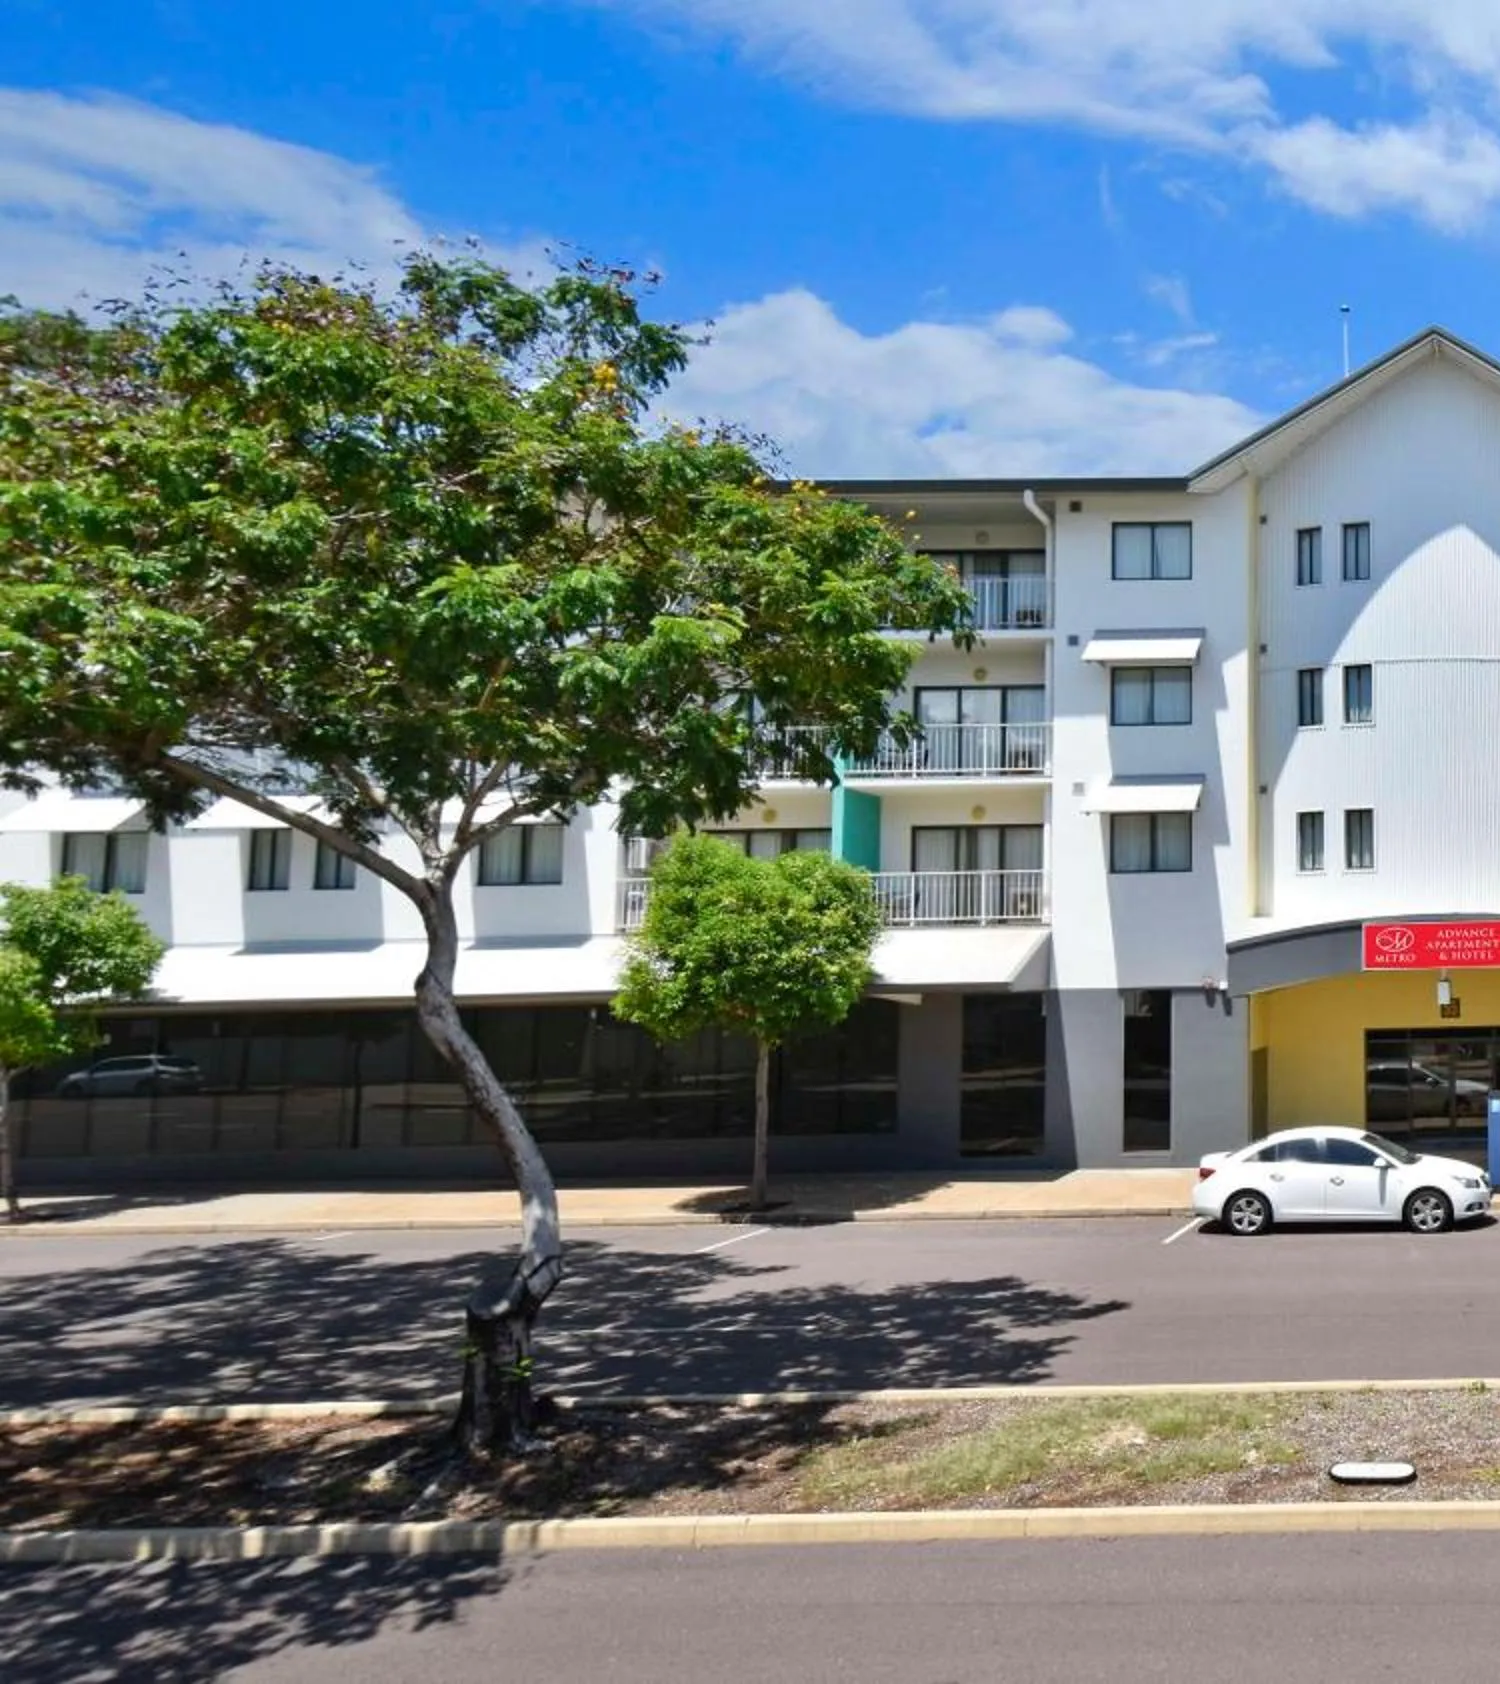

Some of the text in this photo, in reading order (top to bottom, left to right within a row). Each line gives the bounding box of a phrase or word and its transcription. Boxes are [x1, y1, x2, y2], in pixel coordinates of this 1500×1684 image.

[1437, 928, 1496, 938] ADVANCE
[1374, 953, 1416, 963] METRO
[1451, 951, 1495, 960] HOTEL
